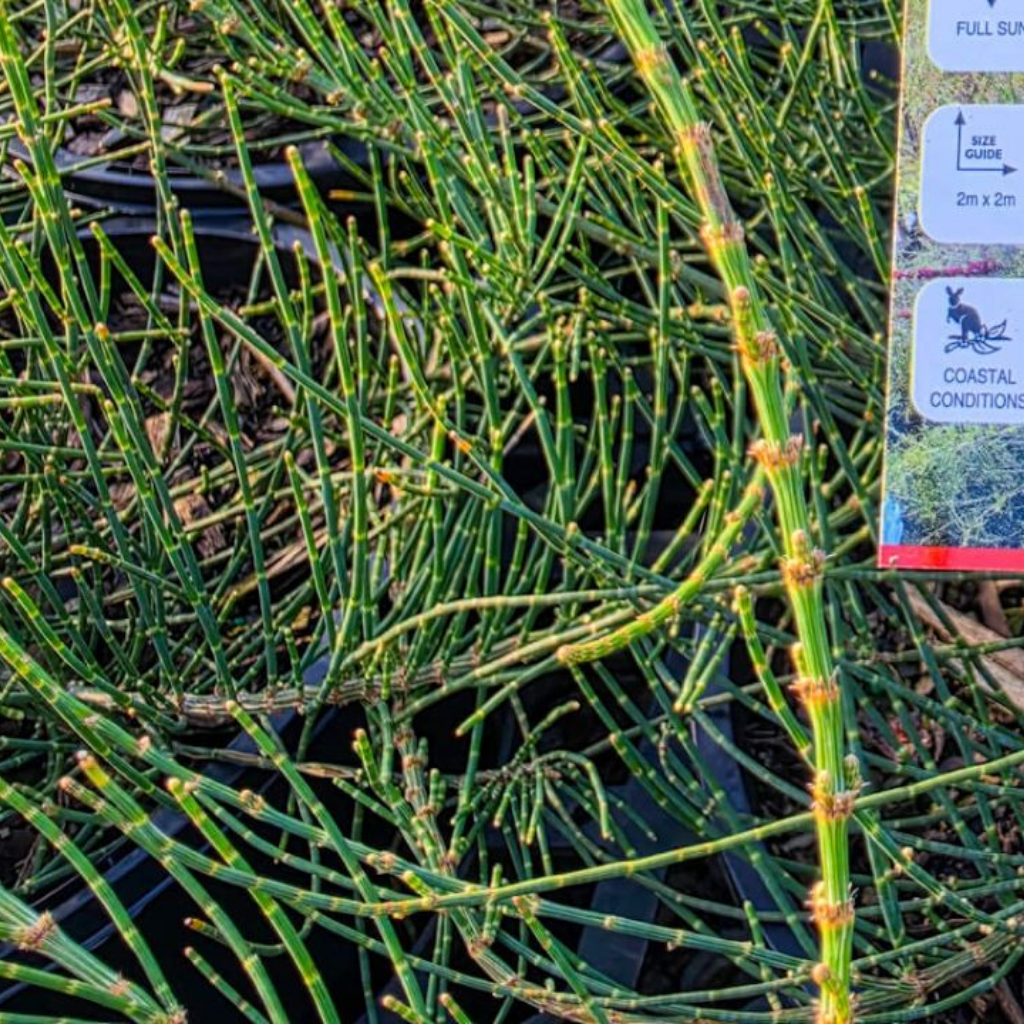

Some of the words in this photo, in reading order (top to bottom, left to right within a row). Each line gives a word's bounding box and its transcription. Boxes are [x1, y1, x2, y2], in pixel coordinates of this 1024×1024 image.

[956, 20, 993, 37] FULL
[971, 135, 997, 146] SIZE
[964, 148, 1003, 160] GUIDE
[956, 191, 978, 207] 2m
[982, 194, 990, 207] x
[994, 191, 1017, 207] 2m
[943, 367, 1017, 385] COASTAL
